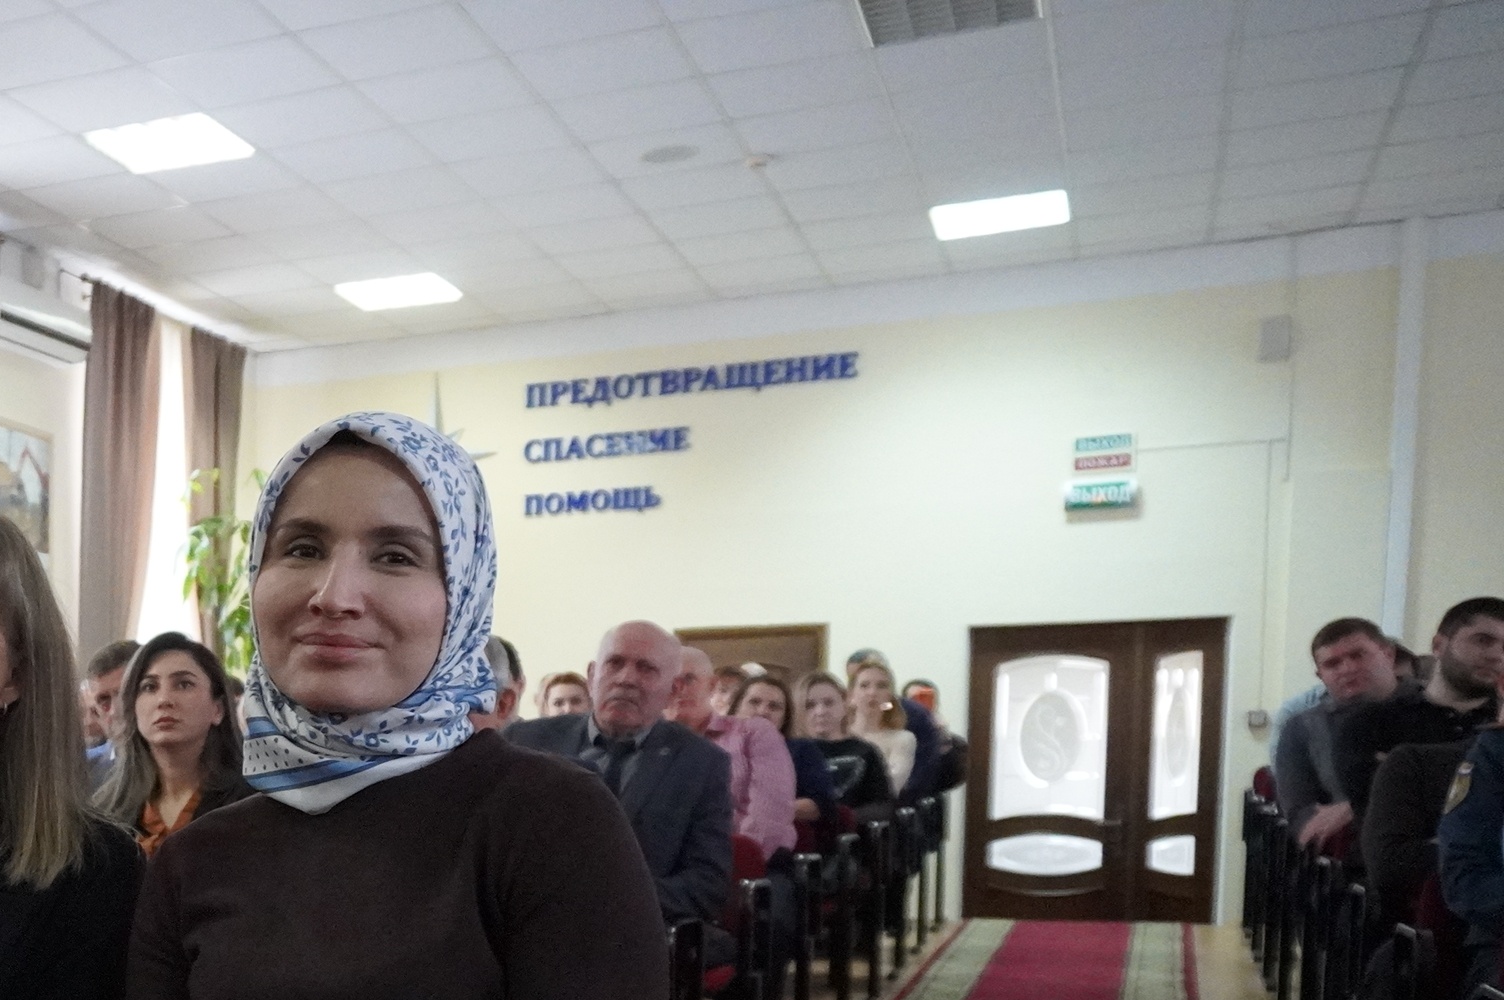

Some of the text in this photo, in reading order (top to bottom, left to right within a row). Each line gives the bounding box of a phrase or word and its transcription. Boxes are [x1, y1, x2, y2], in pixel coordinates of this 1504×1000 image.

[525, 351, 859, 408] ПРЕДОТВРАЩЕНИЕ
[524, 426, 691, 464] СПАСЕНИЕ
[524, 486, 662, 517] ПОМОЩЬ
[1070, 484, 1131, 503] ВЫХОД
